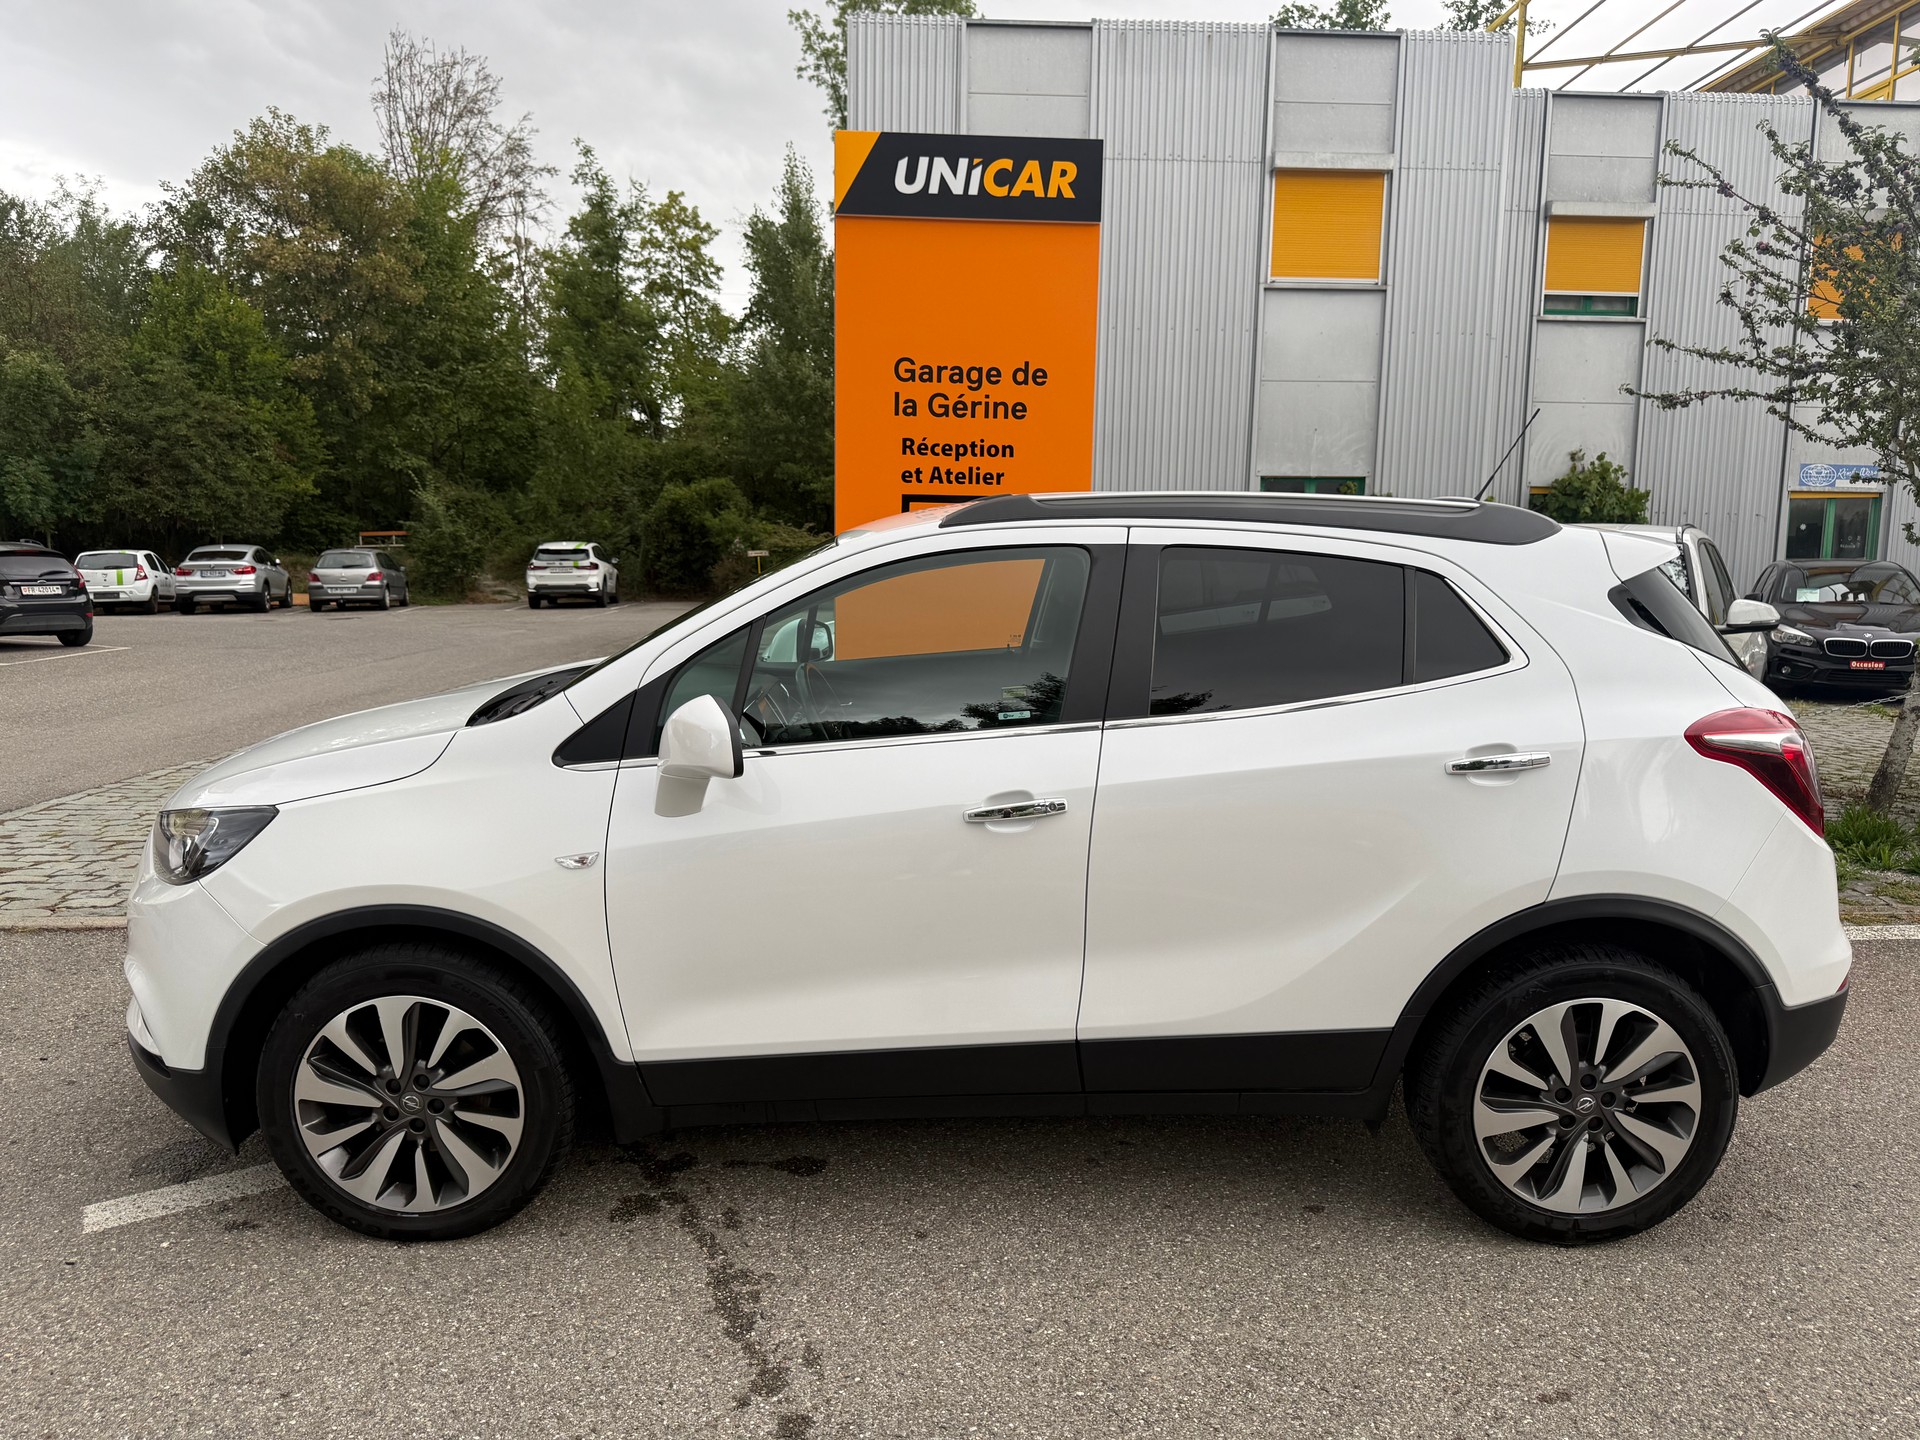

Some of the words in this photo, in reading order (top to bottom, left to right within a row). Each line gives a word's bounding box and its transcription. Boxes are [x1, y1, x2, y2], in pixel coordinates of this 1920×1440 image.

[893, 357, 1002, 391] Garage
[1011, 360, 1048, 387] de
[893, 391, 918, 417] la
[927, 392, 1028, 420] Gérine
[901, 437, 1015, 462] Réception
[901, 467, 923, 484] et
[928, 466, 1005, 486] Atelier
